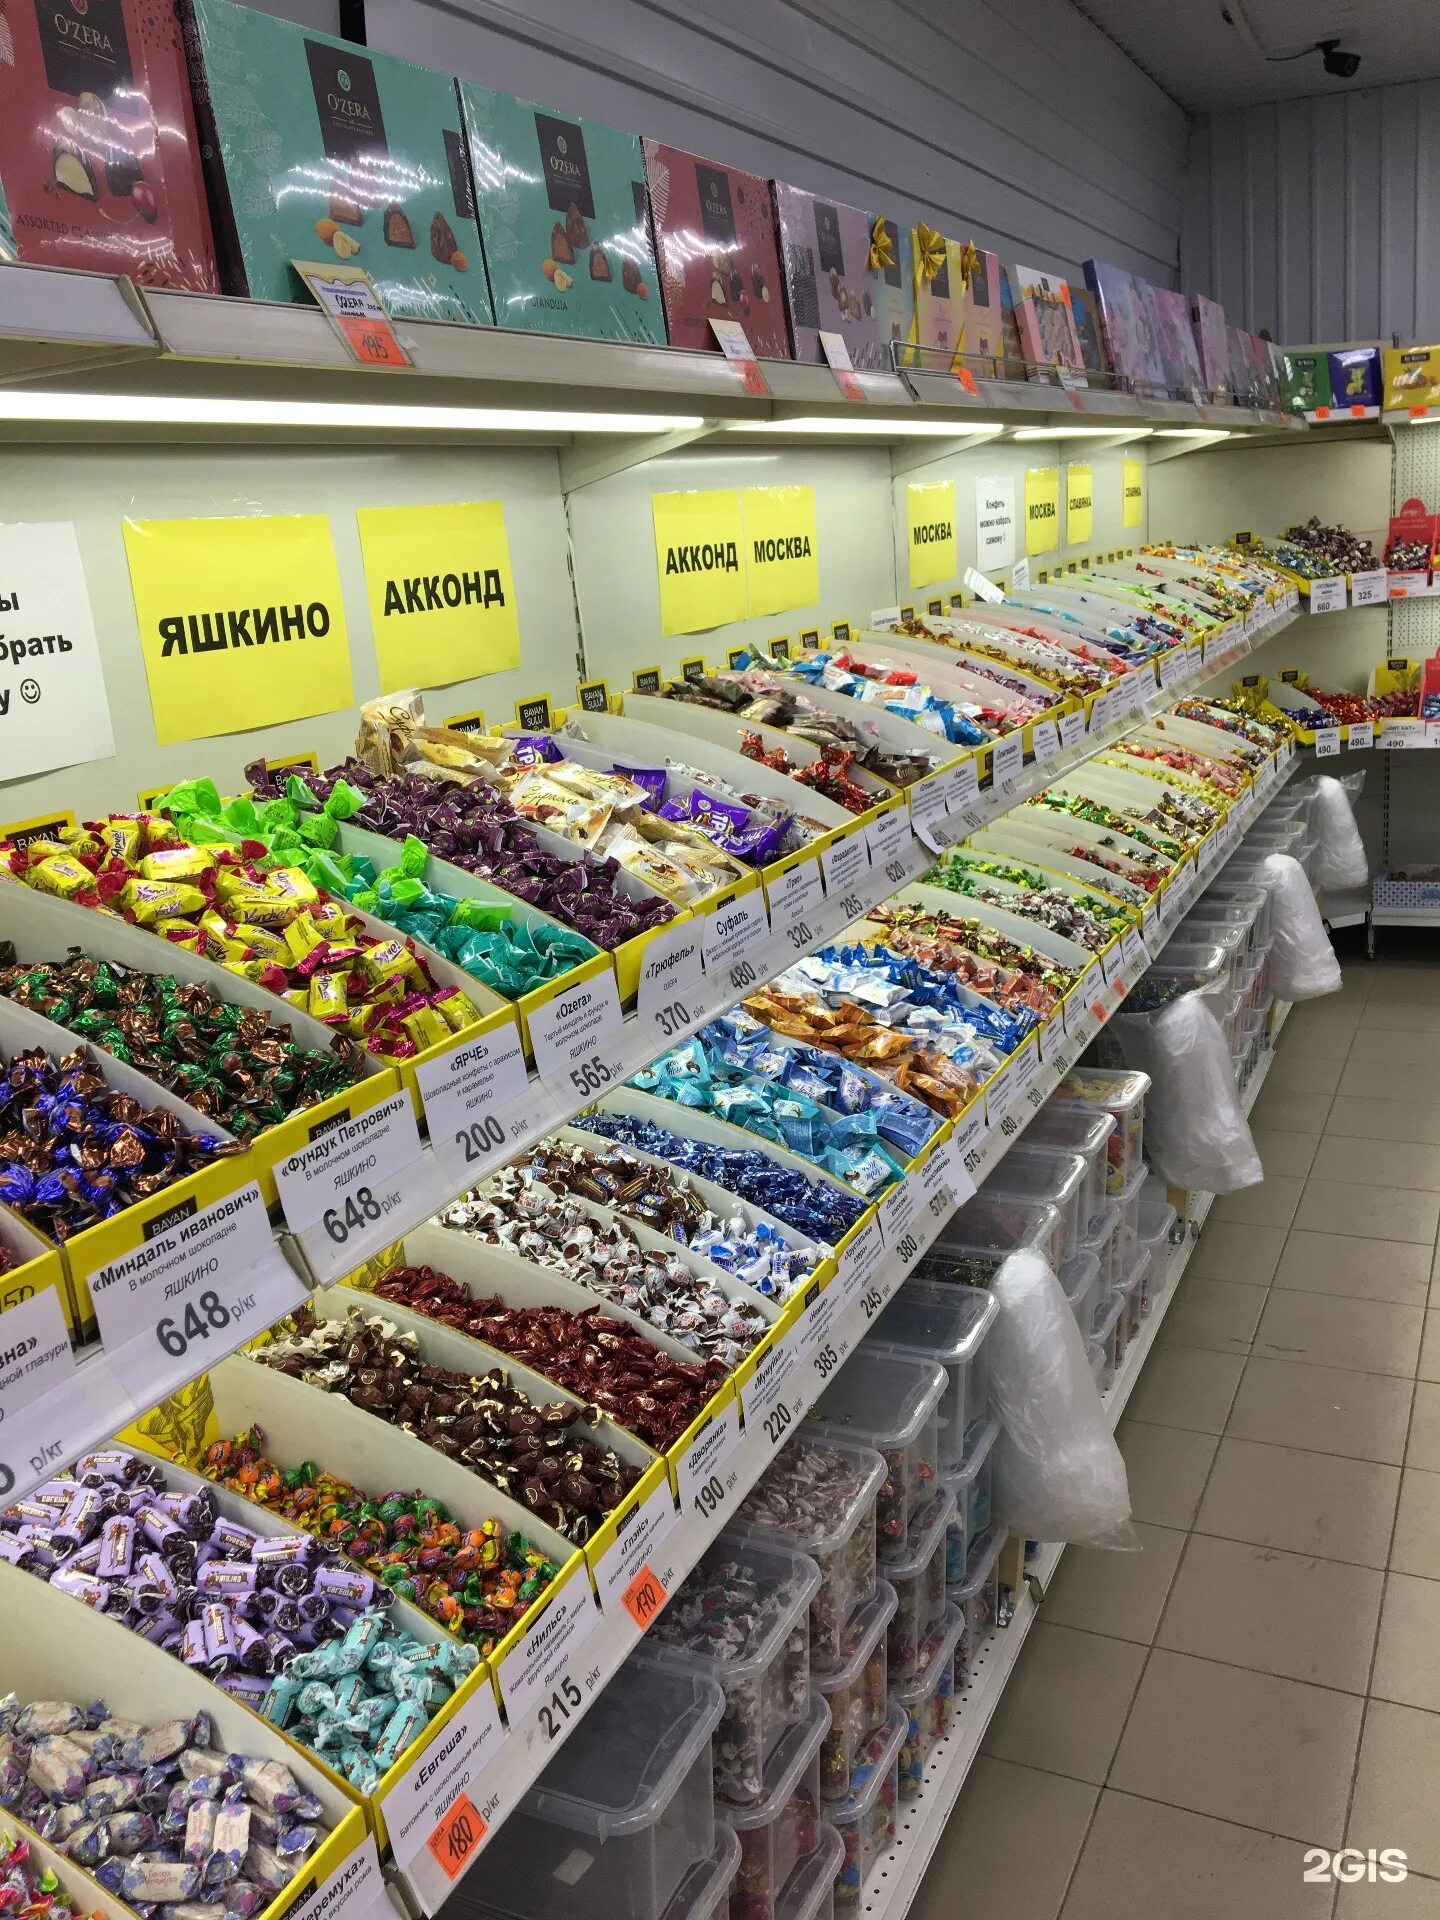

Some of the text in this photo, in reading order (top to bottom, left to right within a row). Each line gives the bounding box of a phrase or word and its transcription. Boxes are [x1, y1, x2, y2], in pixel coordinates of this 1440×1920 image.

[55, 14, 114, 53] O'ZERA
[327, 93, 371, 121] O'ZERA
[16, 214, 69, 235] ASSORTED
[1029, 502, 1056, 521] МОСКВА
[753, 535, 812, 564] МОСКВА
[913, 521, 952, 546] МОСКВА
[665, 541, 740, 576] АККОНД
[383, 568, 505, 617] АККОНД
[1317, 602, 1330, 611] 660
[1358, 591, 1372, 600] 325
[158, 602, 330, 657] ЯШКИНО
[523, 704, 544, 717] BAYAN
[584, 689, 602, 701] BAYAN
[527, 714, 543, 727] SULU
[1318, 745, 1331, 754] 490
[1351, 738, 1364, 746] 490
[16, 831, 60, 852] BAYAN
[885, 860, 906, 883] 620
[839, 893, 864, 919] 285
[786, 921, 812, 948] 320
[645, 944, 695, 980] «Трюфель»
[729, 960, 757, 990] 480
[555, 993, 592, 1020] «Ozera»
[654, 1001, 691, 1036] 370
[450, 1044, 489, 1072] «ЯРЧЕ»
[569, 1035, 598, 1060] ЯШКИНО
[423, 1077, 463, 1102] Шоколадные
[462, 1063, 489, 1083] конфеты
[493, 1047, 521, 1067] арахисом
[569, 1055, 611, 1097] 565
[1053, 1055, 1068, 1075] 200
[461, 1073, 495, 1096] карамелью
[465, 1089, 493, 1111] ЯШКИНО
[1027, 1090, 1043, 1107] 320
[281, 1099, 405, 1178] «Фундук Петрович»
[455, 1115, 530, 1163] 200 р/кг
[1001, 1116, 1018, 1137] 480
[305, 1170, 312, 1182] В
[313, 1150, 352, 1177] молочном
[333, 1154, 377, 1190] ЯШКИНО
[964, 1149, 981, 1173] 575
[323, 1186, 402, 1243] 648 р/кг
[929, 1190, 948, 1217] 575
[151, 1207, 192, 1236] BAYAN
[92, 1189, 260, 1293] «Миндаль иванович»
[129, 1222, 237, 1291] В молочном шоколадне
[896, 1234, 918, 1264] 380
[164, 1257, 220, 1301] ЯШКИНО
[860, 1287, 882, 1319] 245
[156, 1290, 258, 1358] 648 р/кг
[25, 1340, 68, 1374] глазури
[813, 1343, 838, 1379] 385
[763, 1402, 792, 1444] 220
[30, 1440, 63, 1475] р/кг
[688, 1421, 729, 1470] «Дворянка»
[693, 1470, 738, 1519] 190 р/кг
[621, 1517, 649, 1557] «Глэйс»
[628, 1544, 654, 1580] ЯШКИНО
[326, 1586, 353, 1598] ЕВГЕША
[660, 1567, 675, 1590] р/кг
[526, 1604, 567, 1658] «Нильс»
[544, 1653, 570, 1687] Яшкино
[538, 1665, 602, 1740] 215 р/кг
[414, 1725, 468, 1792] «Евгеша»
[399, 1800, 429, 1839] Батончик
[433, 1748, 472, 1797] шоколадным
[472, 1723, 493, 1750] вкусом
[434, 1771, 470, 1821] ЯШКИНО
[482, 1792, 501, 1822] р/кг
[430, 1826, 446, 1848] ЦЕНА
[448, 1815, 474, 1861] 180
[328, 1865, 373, 1920] вкусом рома
